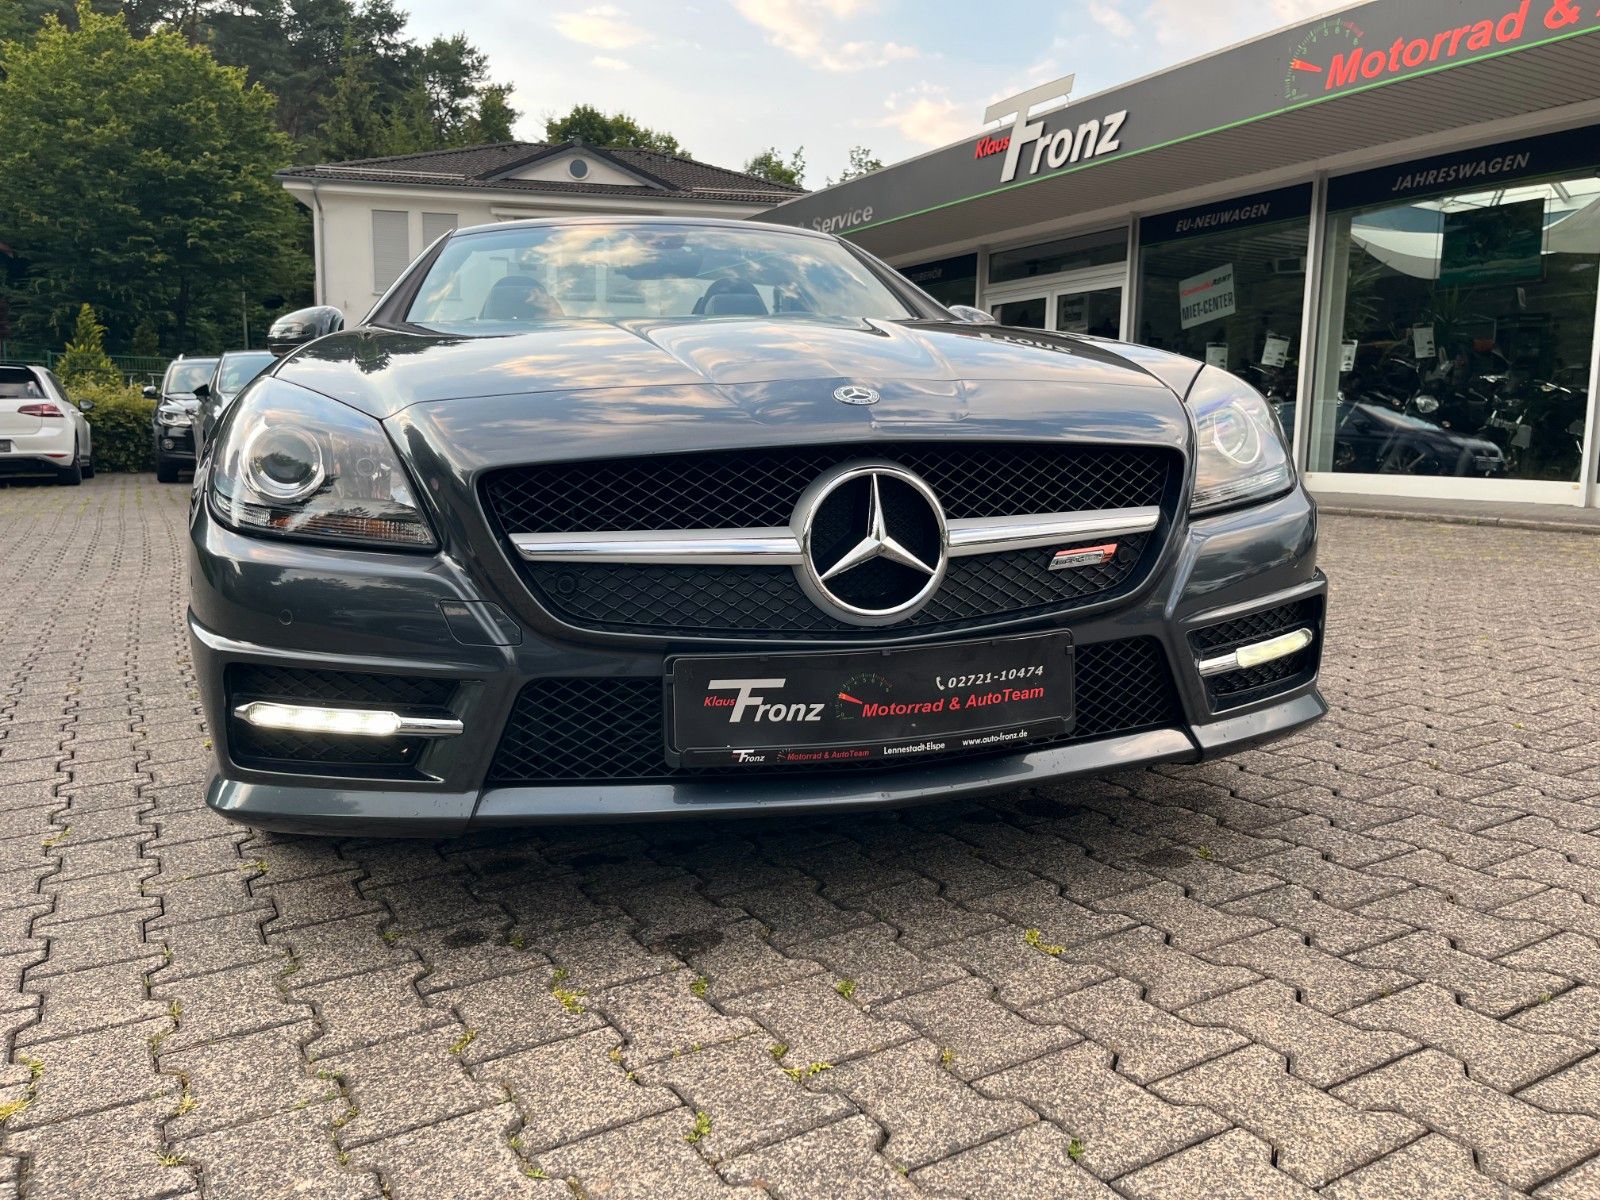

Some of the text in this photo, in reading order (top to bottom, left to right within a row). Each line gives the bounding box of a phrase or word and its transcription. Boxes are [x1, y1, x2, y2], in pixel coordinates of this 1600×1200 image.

[1324, 0, 1580, 91] Motorrad &
[974, 73, 1127, 183] Klaus Fronz
[1391, 152, 1530, 191] JAHRESWAGEN
[812, 206, 874, 233] Service
[1175, 202, 1271, 233] EU-NEUWAGEN
[1181, 292, 1234, 321] MIET-CENTER
[947, 665, 1044, 689] 02721-10474
[703, 696, 736, 707] Klaus
[707, 678, 826, 723] Fronz
[861, 687, 1045, 718] Motorrad & AutoTeam
[883, 741, 946, 755] Lennestadt-Elspe
[962, 729, 1028, 747] www.auto-fronz.de
[732, 748, 766, 763] Fronz
[787, 750, 869, 761] Motorrad & AutoTeam
